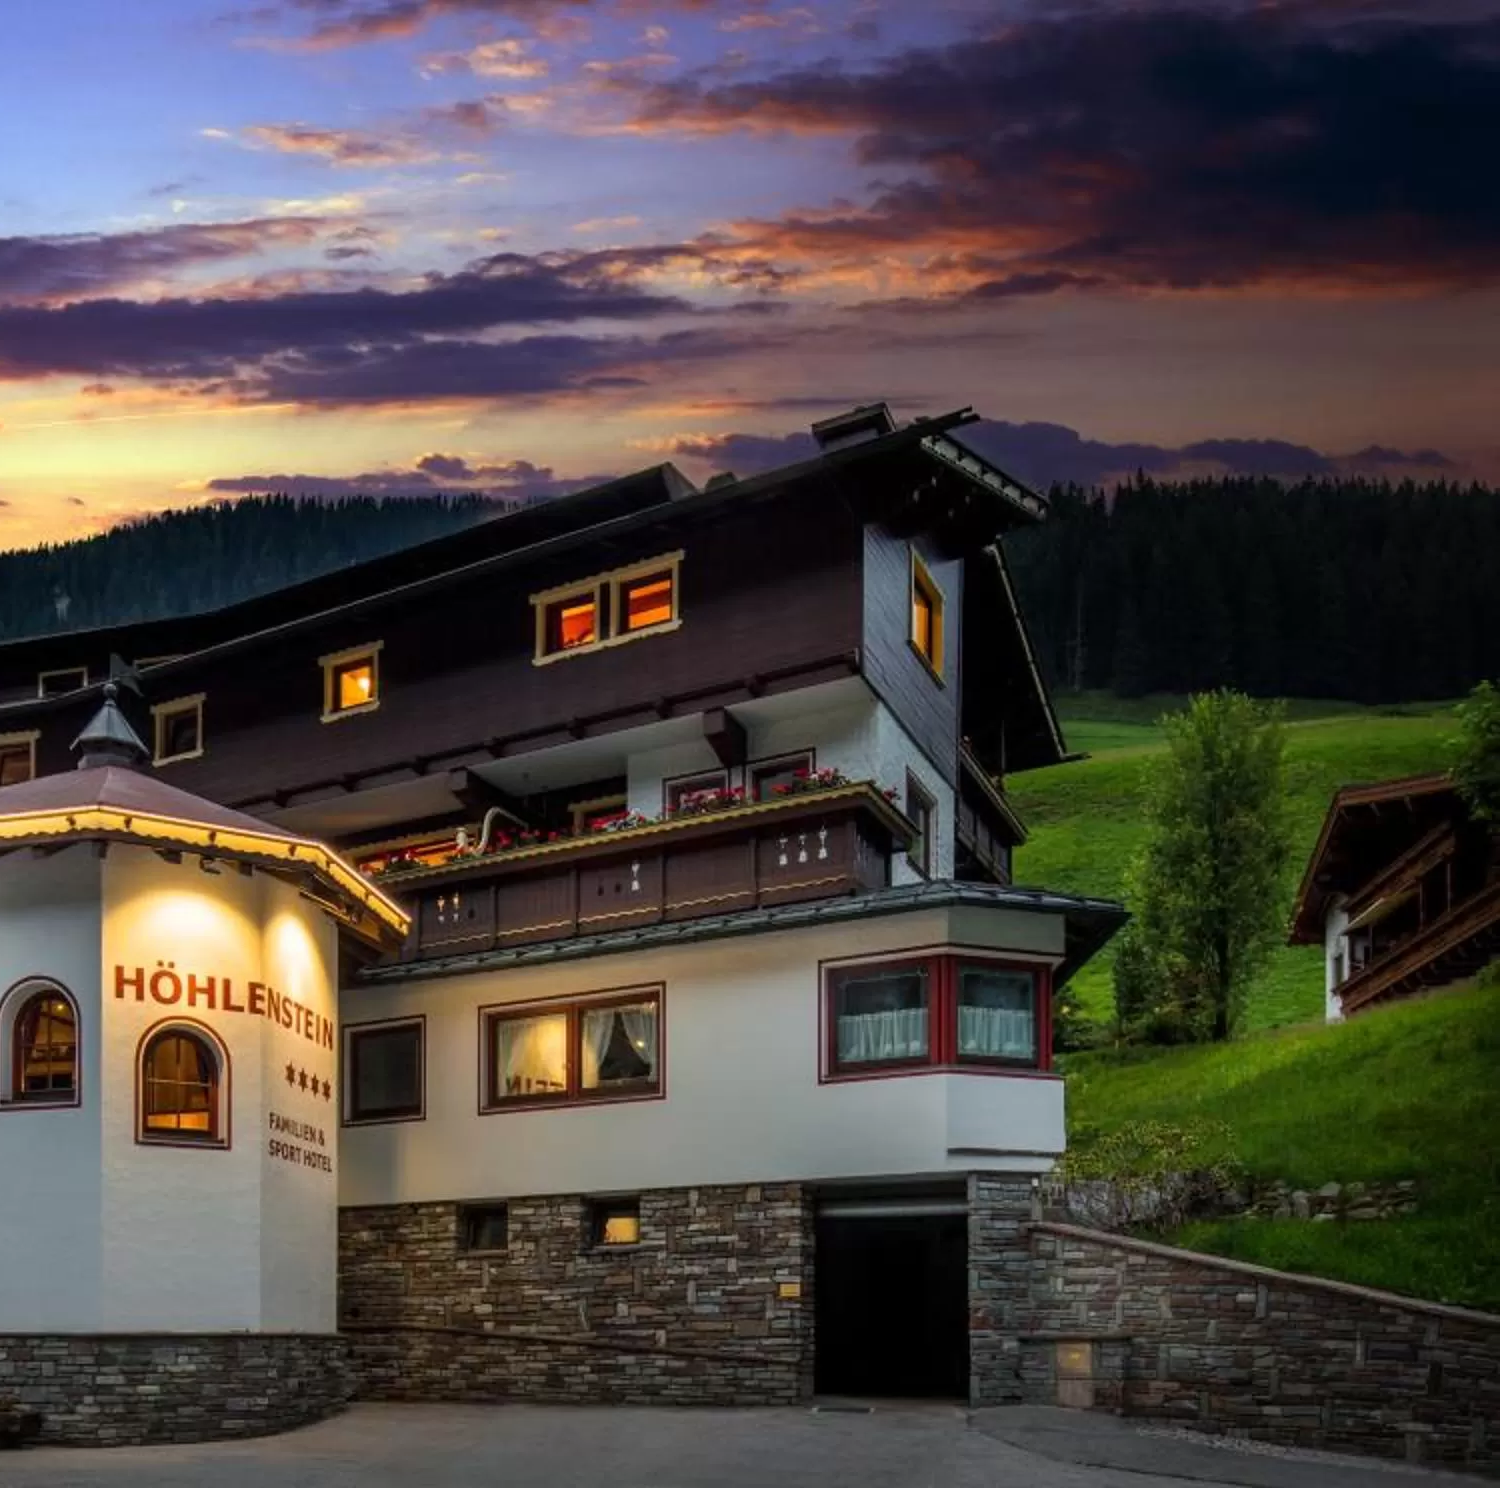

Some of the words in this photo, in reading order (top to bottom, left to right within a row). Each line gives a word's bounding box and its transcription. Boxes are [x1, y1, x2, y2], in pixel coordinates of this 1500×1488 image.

[114, 960, 334, 1050] HÖHLENSTEIN
[269, 1112, 317, 1144] FAMILIEN
[318, 1128, 325, 1147] &
[268, 1139, 301, 1164] SPORT
[303, 1149, 333, 1173] HOTEL
